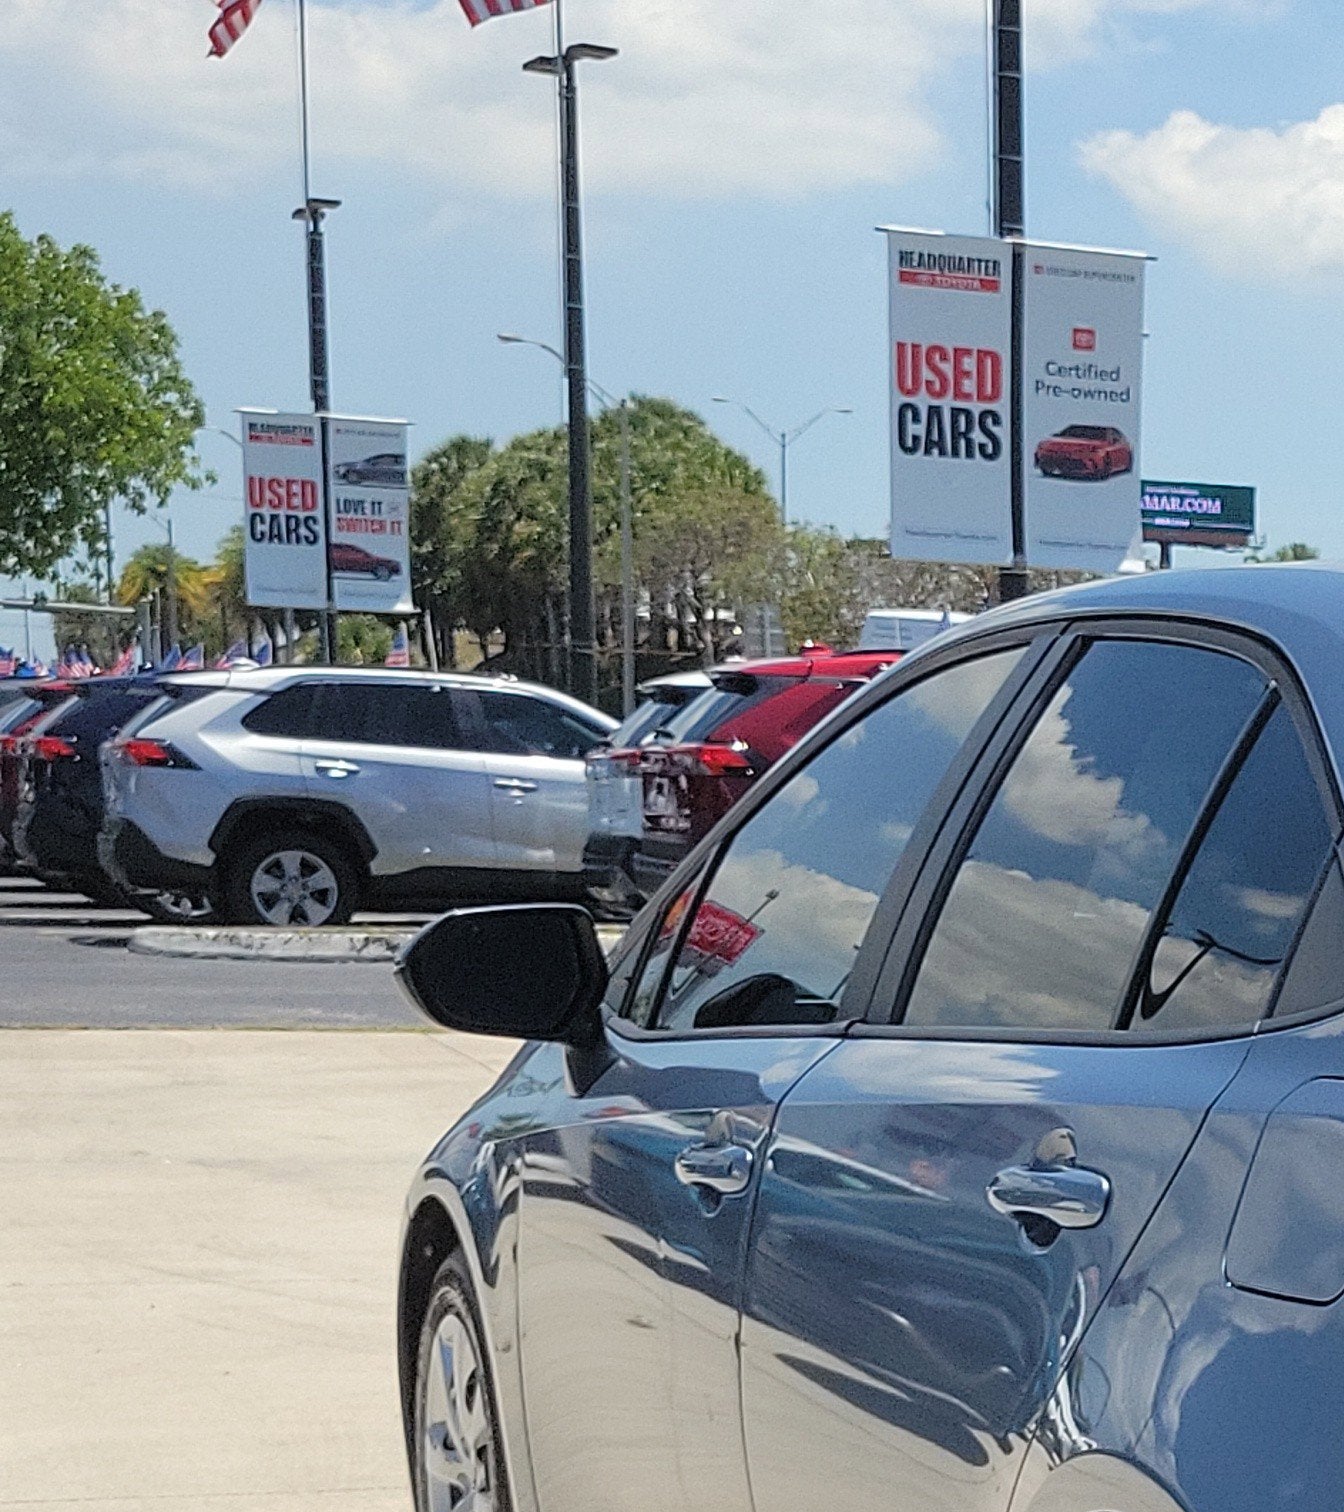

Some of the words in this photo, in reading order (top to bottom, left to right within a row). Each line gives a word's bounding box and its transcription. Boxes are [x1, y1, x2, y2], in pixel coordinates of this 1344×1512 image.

[899, 250, 1000, 277] HEADQUARTER
[896, 341, 1002, 404] USED
[1046, 361, 1120, 382] Certified
[1035, 379, 1130, 403] Pre-owned
[898, 402, 1003, 461] CARS
[248, 477, 318, 512] USED
[336, 498, 366, 516] LOVE
[371, 501, 382, 516] IT
[250, 513, 319, 546] CARS
